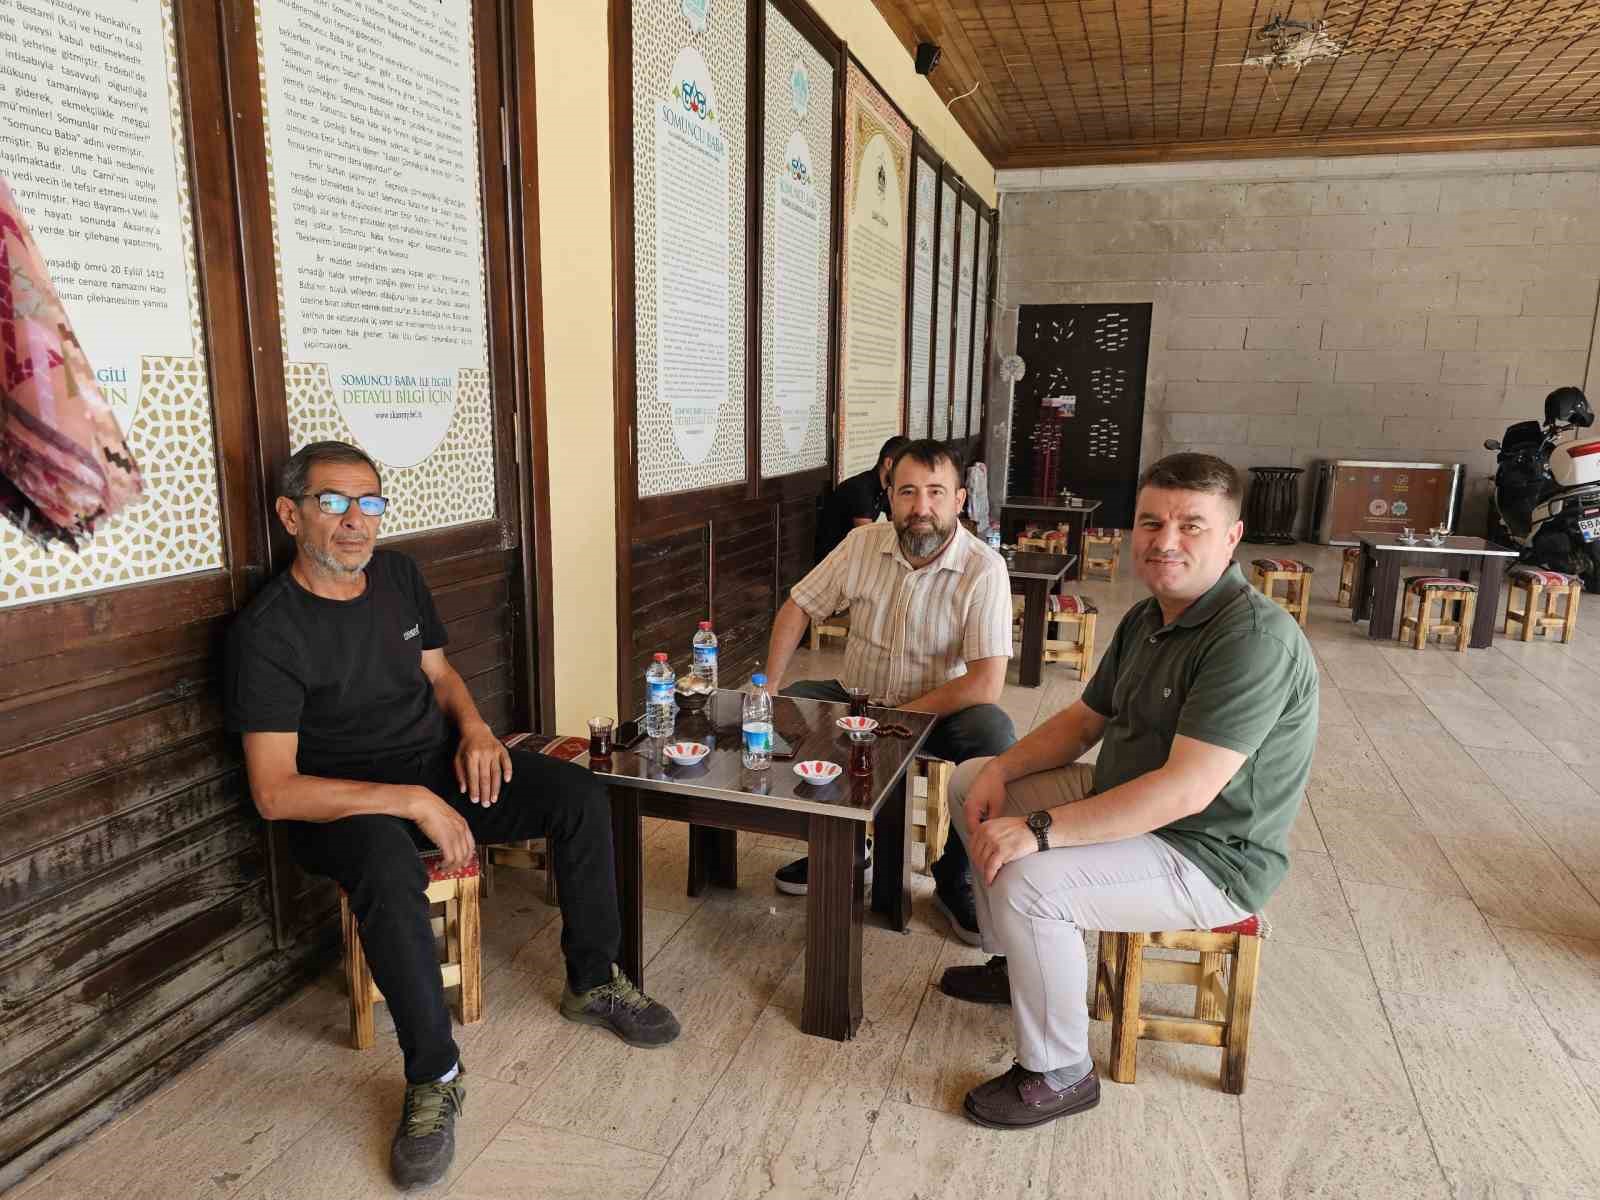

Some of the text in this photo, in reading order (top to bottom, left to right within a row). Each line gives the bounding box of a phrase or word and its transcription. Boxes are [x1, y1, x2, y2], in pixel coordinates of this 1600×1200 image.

[36, 141, 49, 151] Bu
[80, 216, 115, 227] sonunda
[110, 264, 120, 273] 20
